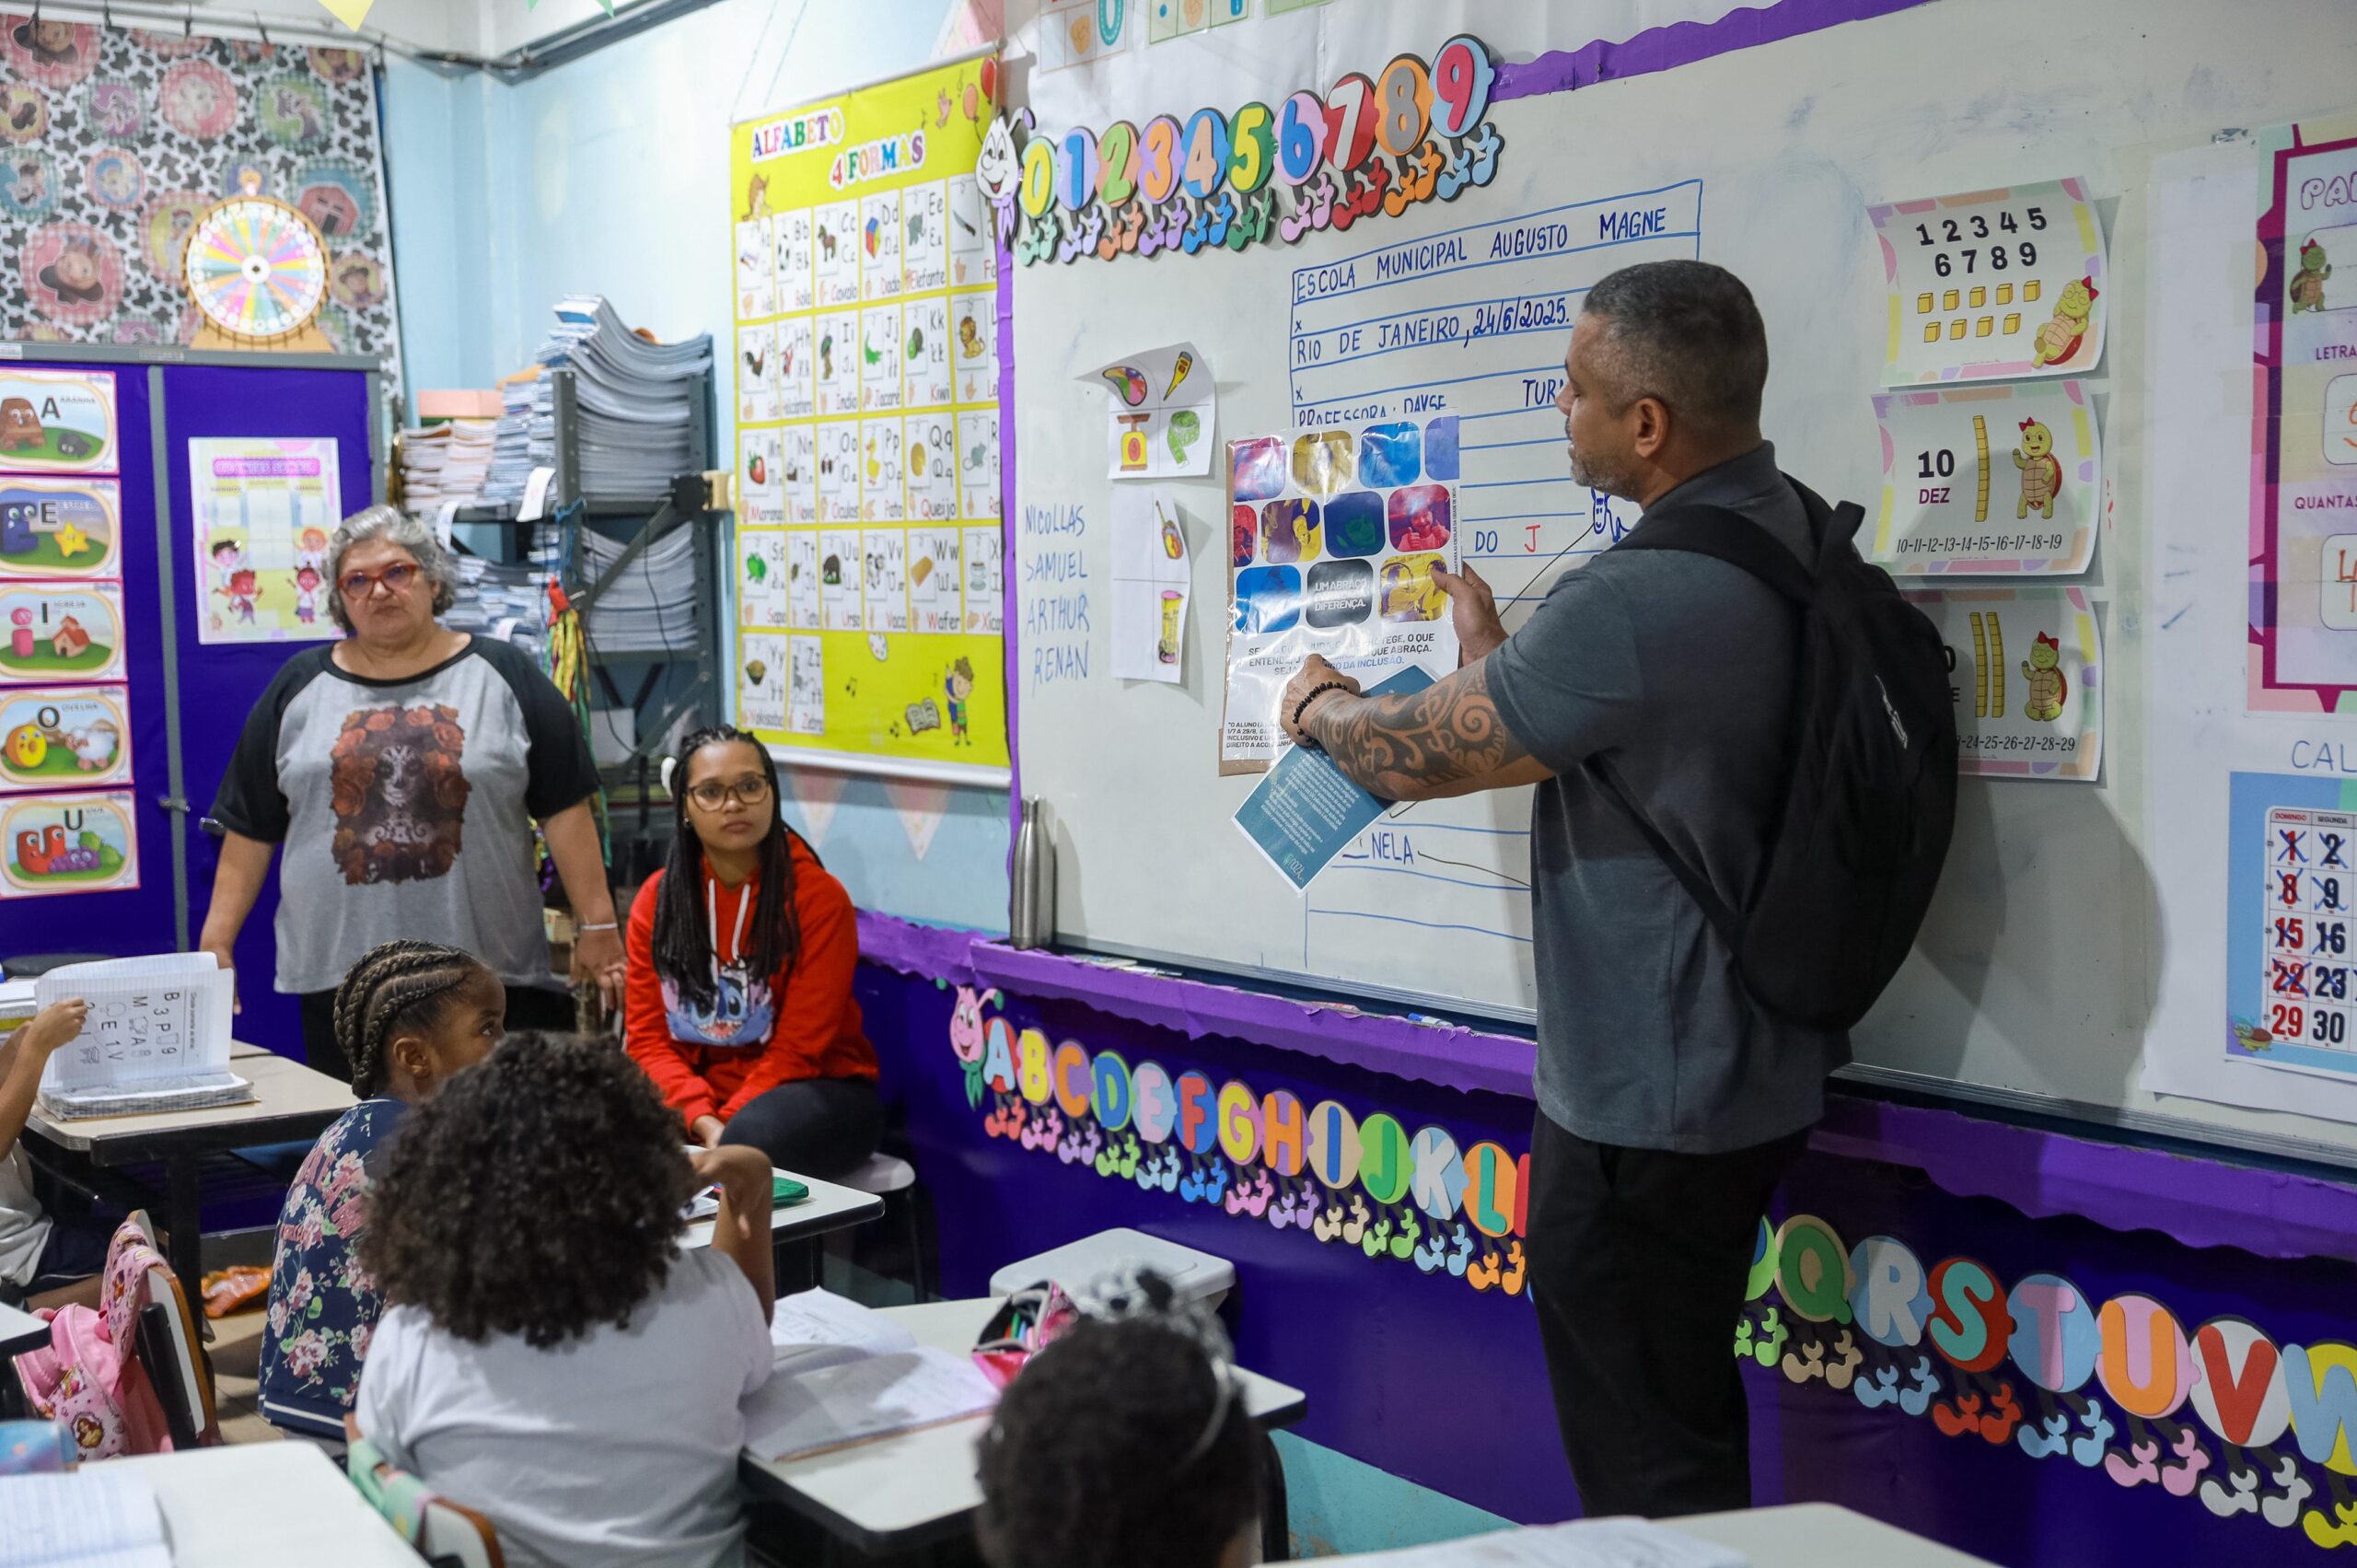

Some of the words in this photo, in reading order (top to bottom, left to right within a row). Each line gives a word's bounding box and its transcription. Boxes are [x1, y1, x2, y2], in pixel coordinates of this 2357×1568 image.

[753, 110, 842, 157] ALFABETO
[1023, 144, 1050, 211] 0
[1065, 134, 1085, 205] 1
[1101, 129, 1132, 203] 2
[1144, 122, 1171, 199] 3
[1188, 116, 1217, 192] 4
[1234, 107, 1265, 192] 5
[1282, 100, 1314, 179] 6
[1327, 82, 1365, 169] 7
[1385, 66, 1421, 150] 8
[1436, 44, 1474, 132] 9
[832, 158, 842, 184] 4
[849, 135, 923, 179] FORMAS
[2301, 171, 2357, 210] PA
[1916, 224, 1934, 246] 1
[1942, 219, 1962, 242] 2
[1969, 215, 1989, 238] 3
[2000, 212, 2018, 233] 4
[2027, 207, 2047, 230] 5
[1296, 263, 1355, 301] ESCOLA
[1376, 237, 1468, 280] MUNICIPAL
[1491, 224, 1568, 259] AUGUSTO
[1599, 207, 1666, 240] MAGNE
[1934, 253, 1951, 277] 6
[1961, 250, 1978, 273] 7
[1991, 246, 2008, 270] 8
[2019, 242, 2037, 266] 9
[1297, 339, 1321, 365] RIO
[1340, 330, 1363, 353] DE
[41, 397, 60, 419] A
[1523, 379, 1563, 407] TUR
[1917, 448, 1955, 479] 10
[1919, 488, 1950, 504] DEZ
[2294, 494, 2357, 509] QUANTA
[41, 503, 57, 523] E
[1026, 504, 1085, 537] NICOLLAS
[1475, 530, 1498, 552] DO
[1525, 525, 1540, 552] J
[1026, 550, 1088, 581] SAMUEL
[41, 602, 47, 623] I
[1025, 589, 1090, 638] ARTHUR
[1315, 598, 1366, 611] DIFERENÇA.
[1415, 633, 1435, 643] QUE
[1032, 641, 1089, 685] RENAN
[38, 707, 60, 728] O
[64, 809, 83, 830] U
[1372, 832, 1413, 865] NELA
[2287, 830, 2295, 861] 1
[2325, 833, 2340, 865] 2
[2282, 874, 2297, 904] 8
[2325, 877, 2339, 908] 9
[2275, 917, 2304, 949] 15
[2316, 922, 2346, 954] 16
[2273, 960, 2305, 994] 22
[2316, 966, 2347, 999] 23
[164, 992, 180, 1002] B
[2271, 1004, 2304, 1037] 29
[2313, 1010, 2345, 1043] 30
[984, 1019, 1014, 1089] A
[1022, 1030, 1047, 1102] B
[1057, 1041, 1085, 1116] C
[1093, 1055, 1128, 1129] D
[1133, 1064, 1163, 1142] E
[1178, 1076, 1205, 1149] F
[1220, 1087, 1255, 1159] G
[1264, 1093, 1301, 1175] H
[1327, 1107, 1341, 1184] I
[1367, 1121, 1396, 1200] J
[1416, 1136, 1453, 1220] K
[1480, 1146, 1506, 1235] L
[1781, 1224, 1852, 1325] Q
[1867, 1240, 1921, 1345] R
[1930, 1261, 1993, 1361] S
[2018, 1284, 2076, 1390] T
[2101, 1300, 2176, 1414] U
[2197, 1326, 2276, 1445] V
